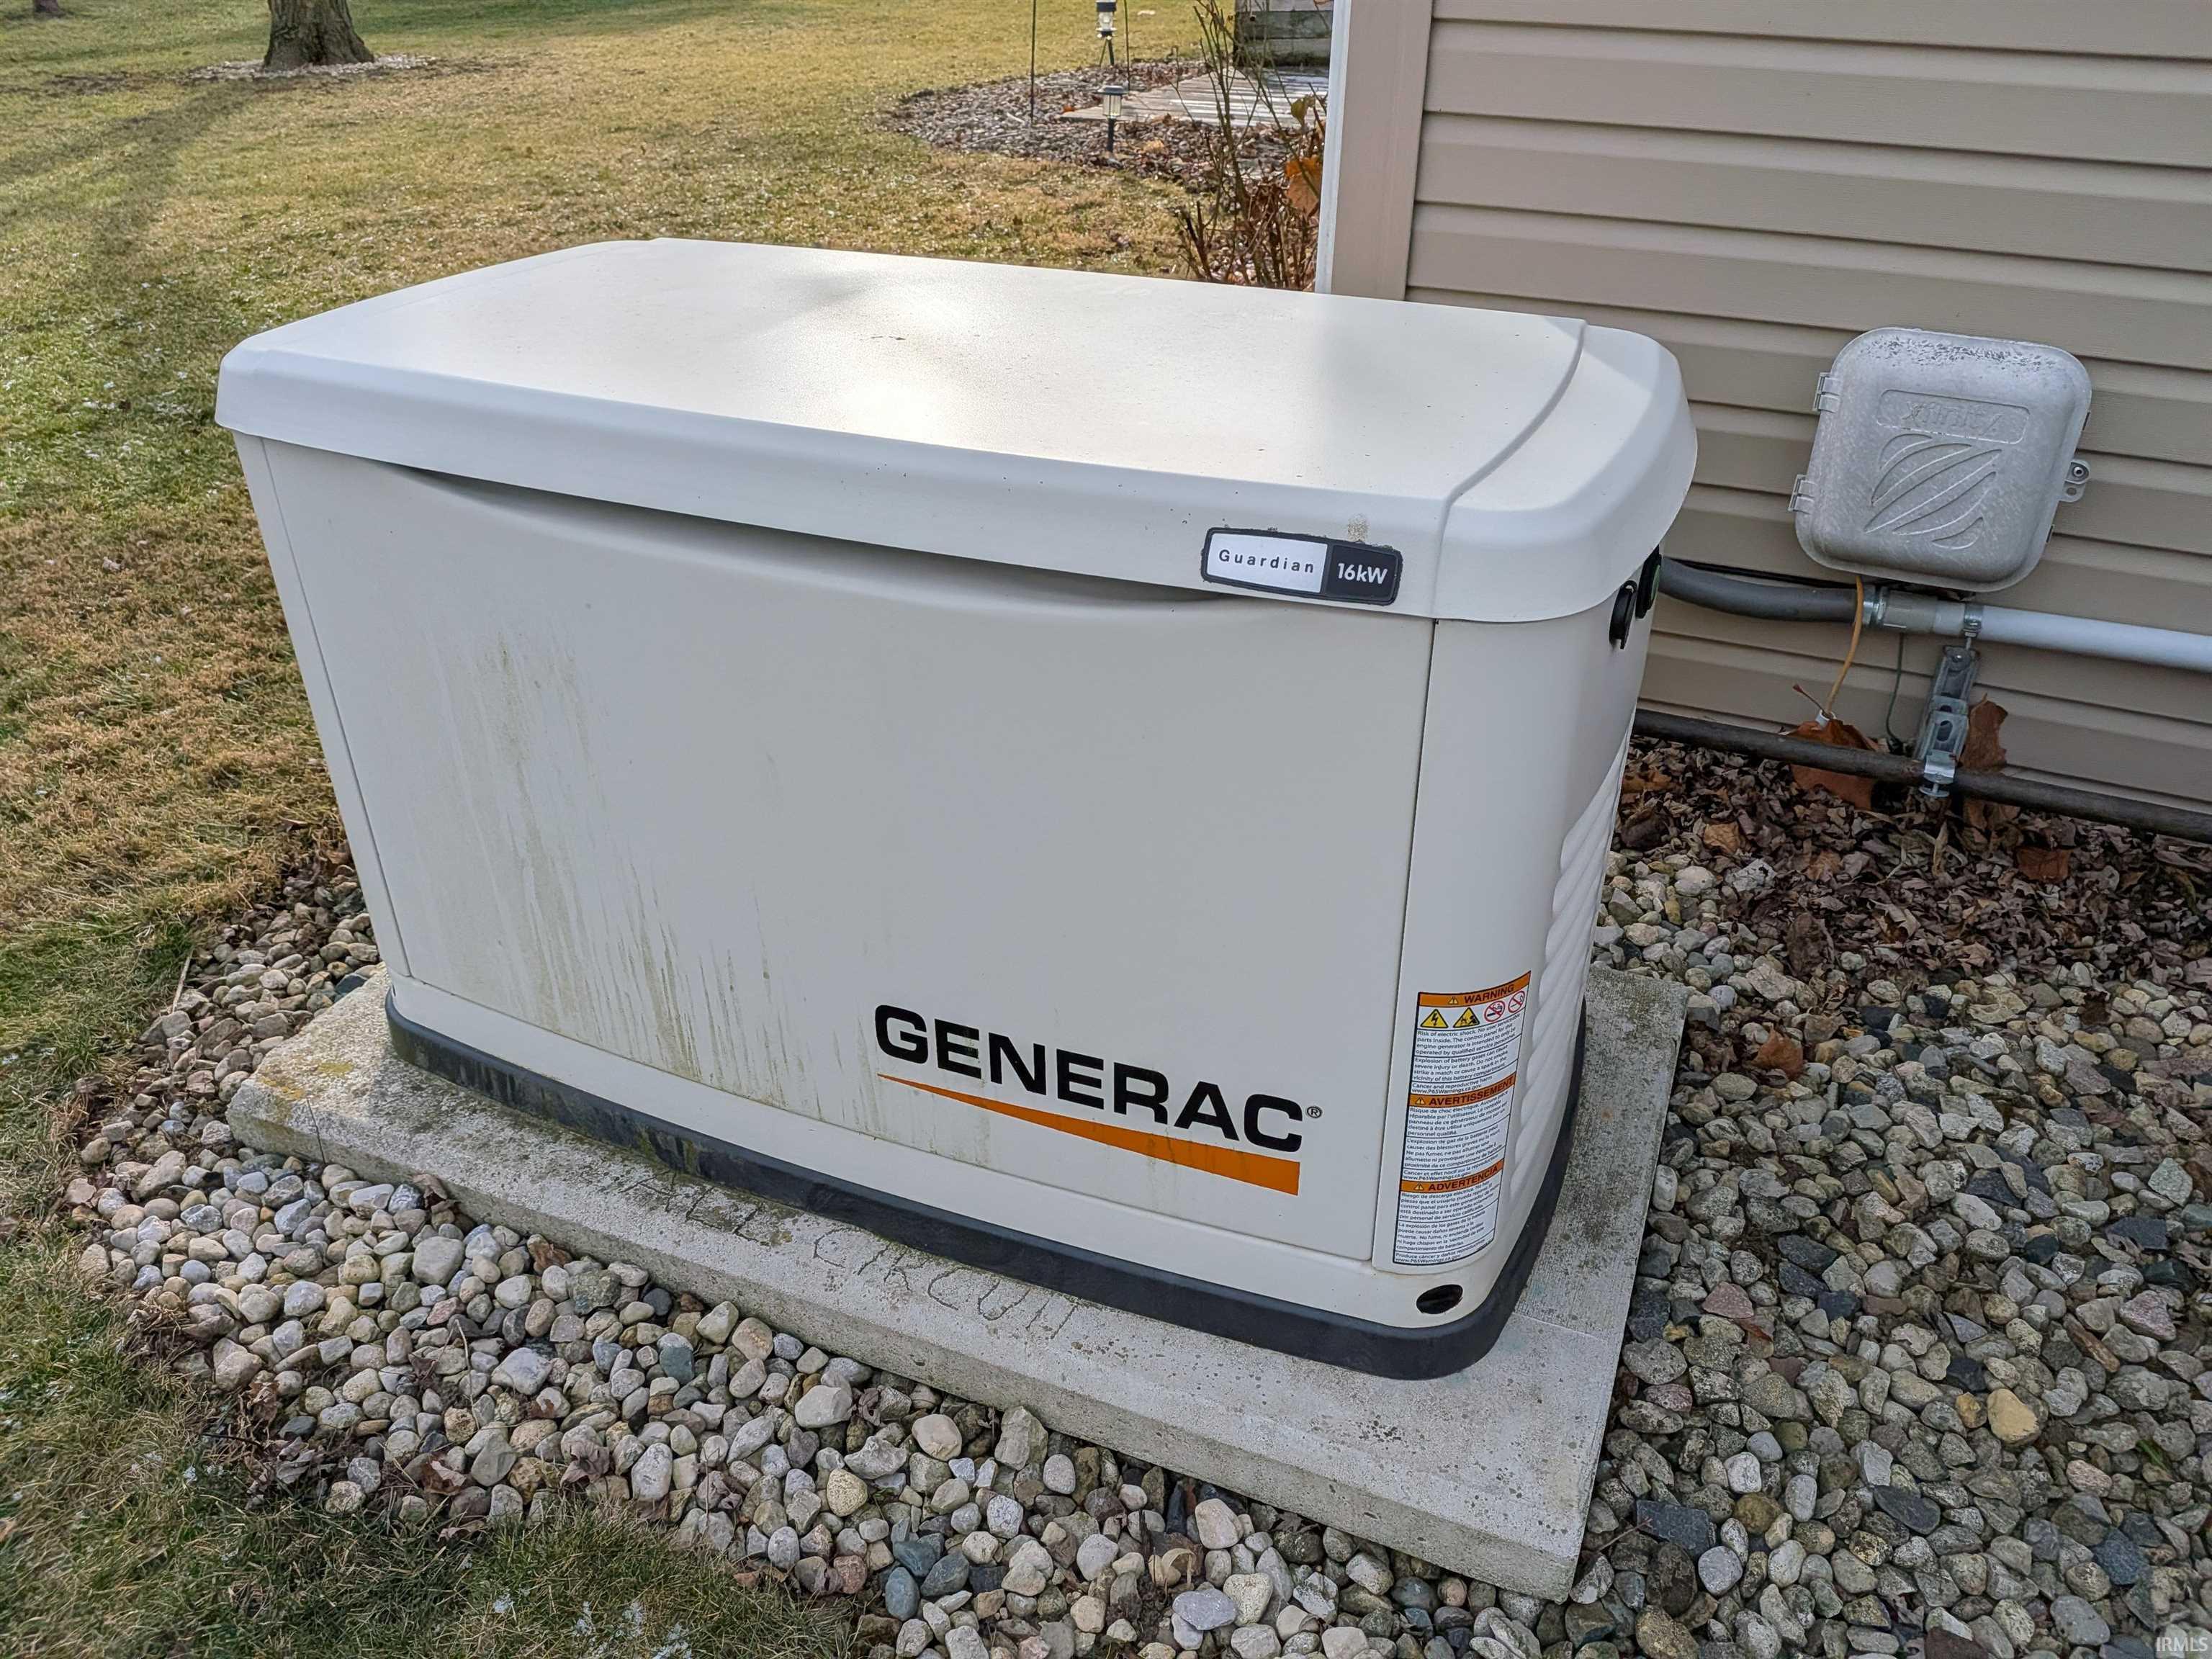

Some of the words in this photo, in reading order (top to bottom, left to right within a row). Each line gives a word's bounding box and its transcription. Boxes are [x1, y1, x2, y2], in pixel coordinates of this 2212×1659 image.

[1218, 549, 1314, 573] Guardian
[1337, 562, 1388, 585] 16kW
[1464, 984, 1514, 1004] WARNING
[1429, 1076, 1513, 1105] AVERTISSEMENT
[1428, 1164, 1498, 1190] ADVERTENCIA
